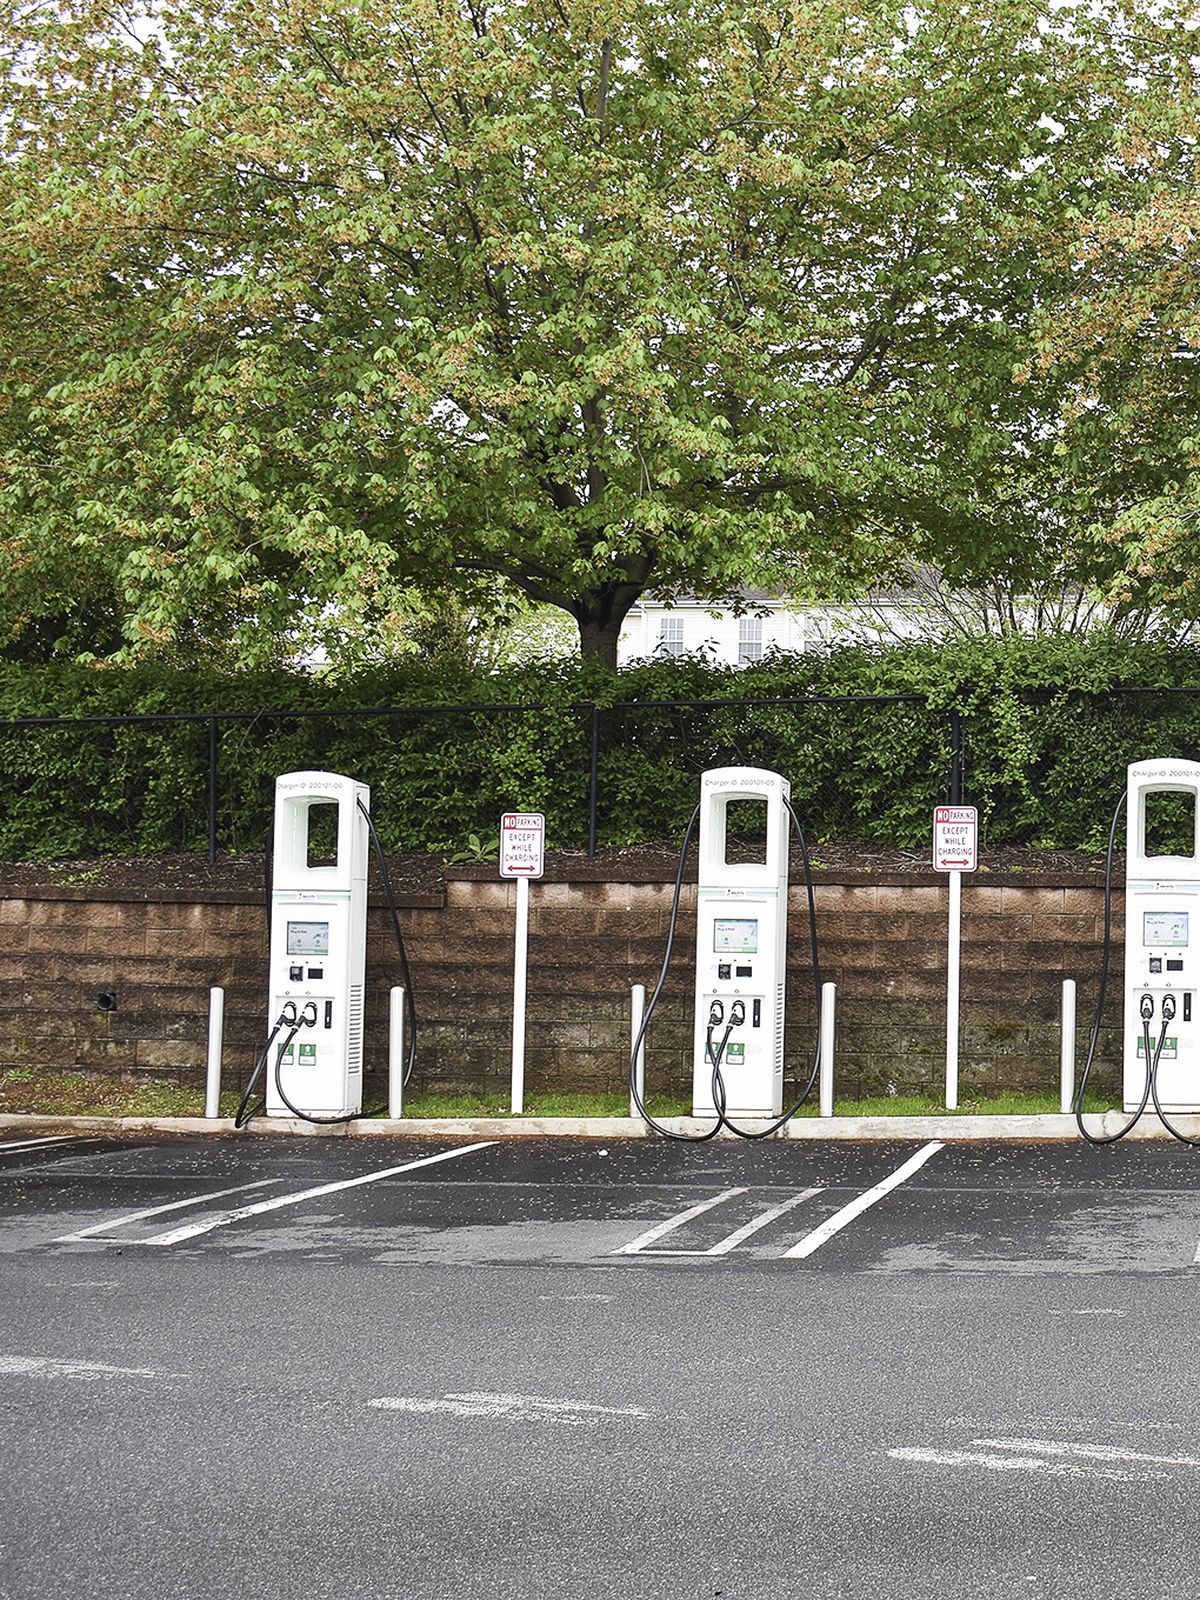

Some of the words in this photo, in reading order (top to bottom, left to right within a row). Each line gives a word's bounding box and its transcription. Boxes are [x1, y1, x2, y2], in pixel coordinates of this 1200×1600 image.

[938, 810, 948, 821] NO
[950, 811, 974, 820] PARKING
[504, 817, 515, 828] NO
[517, 818, 540, 826] PARKING
[942, 826, 968, 835] EXCEPT
[509, 833, 535, 842] EXCEPT
[945, 837, 966, 846] WHILE
[512, 844, 532, 852] WHILE
[938, 847, 972, 856] CHARGING
[505, 854, 539, 862] CHARGING
